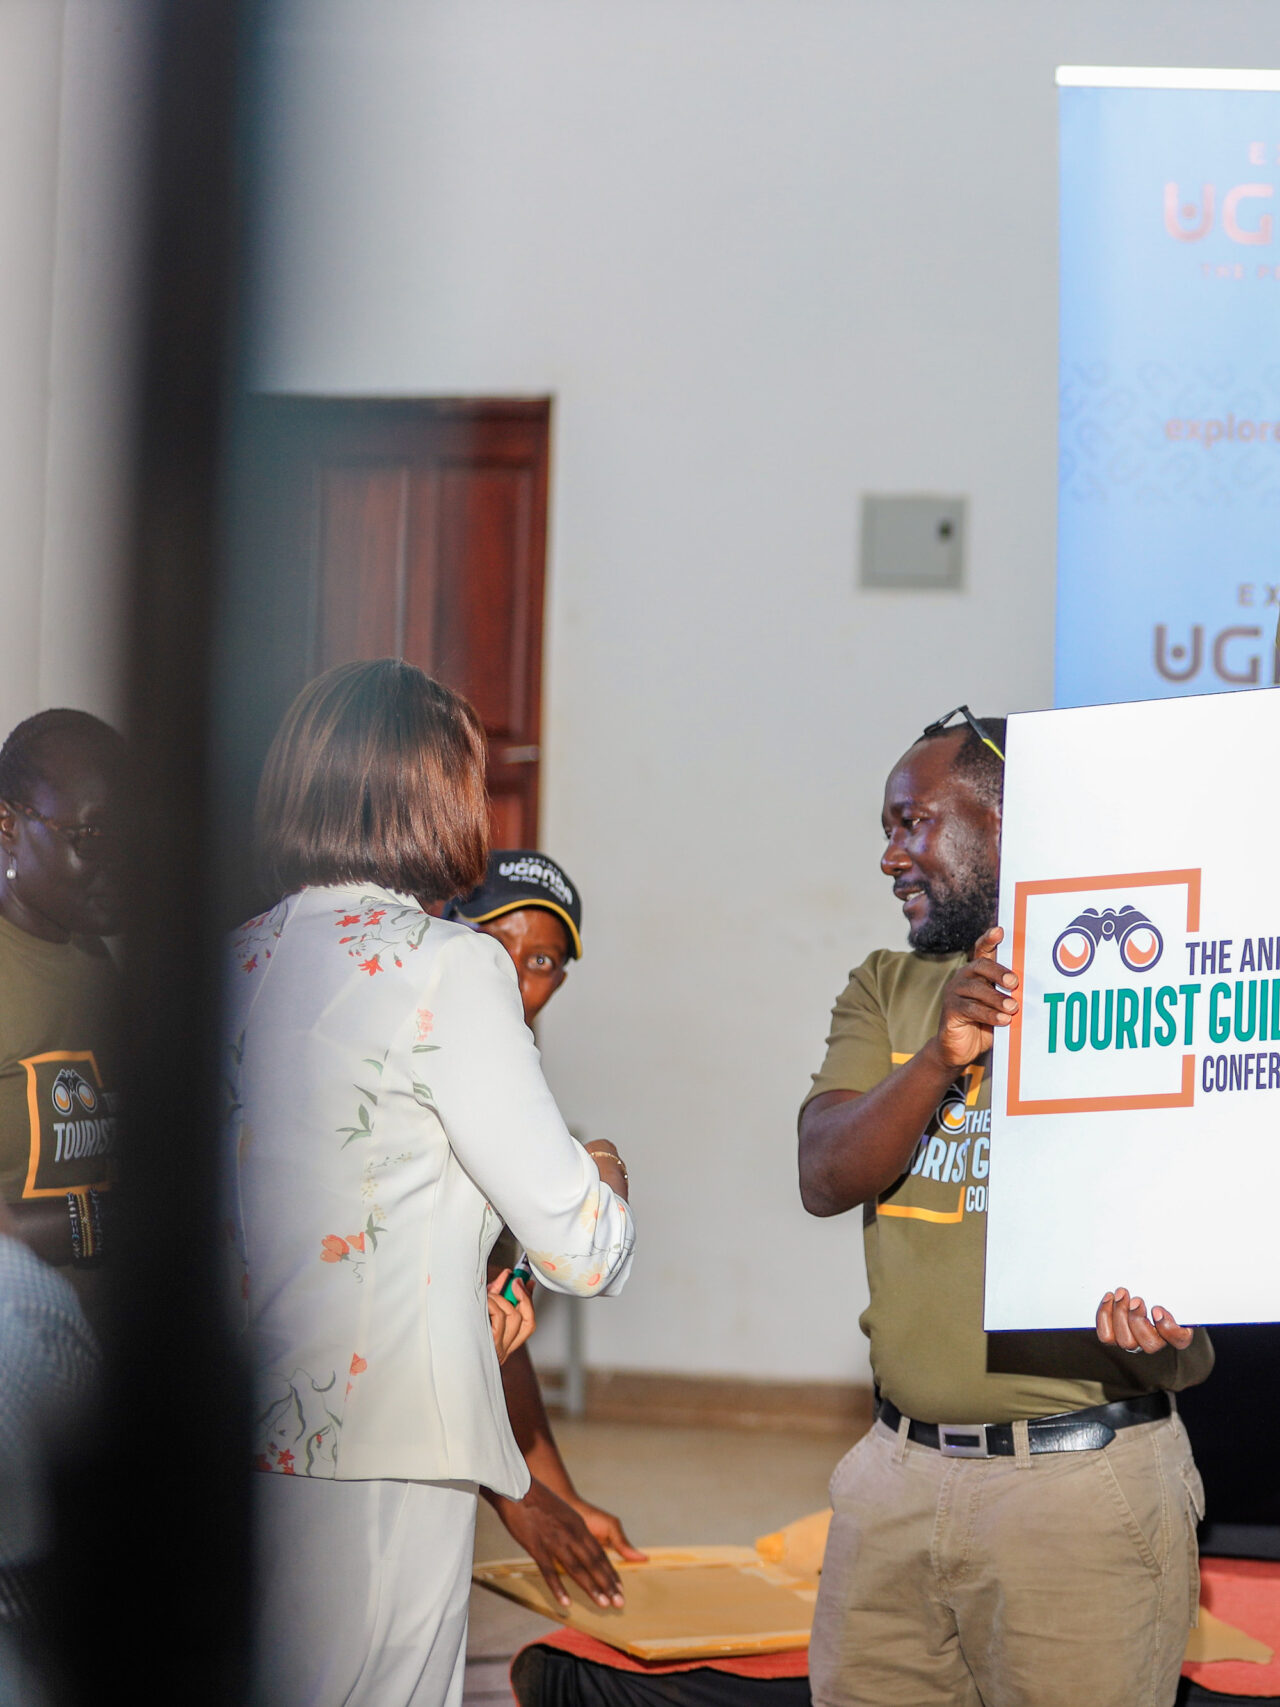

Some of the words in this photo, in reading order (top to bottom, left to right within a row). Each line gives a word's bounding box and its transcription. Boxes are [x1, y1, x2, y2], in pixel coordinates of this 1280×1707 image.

[499, 861, 573, 905] UGANDA
[1185, 940, 1233, 976] THE
[1043, 983, 1202, 1054] TOURIST
[53, 1118, 113, 1163] TOURIS
